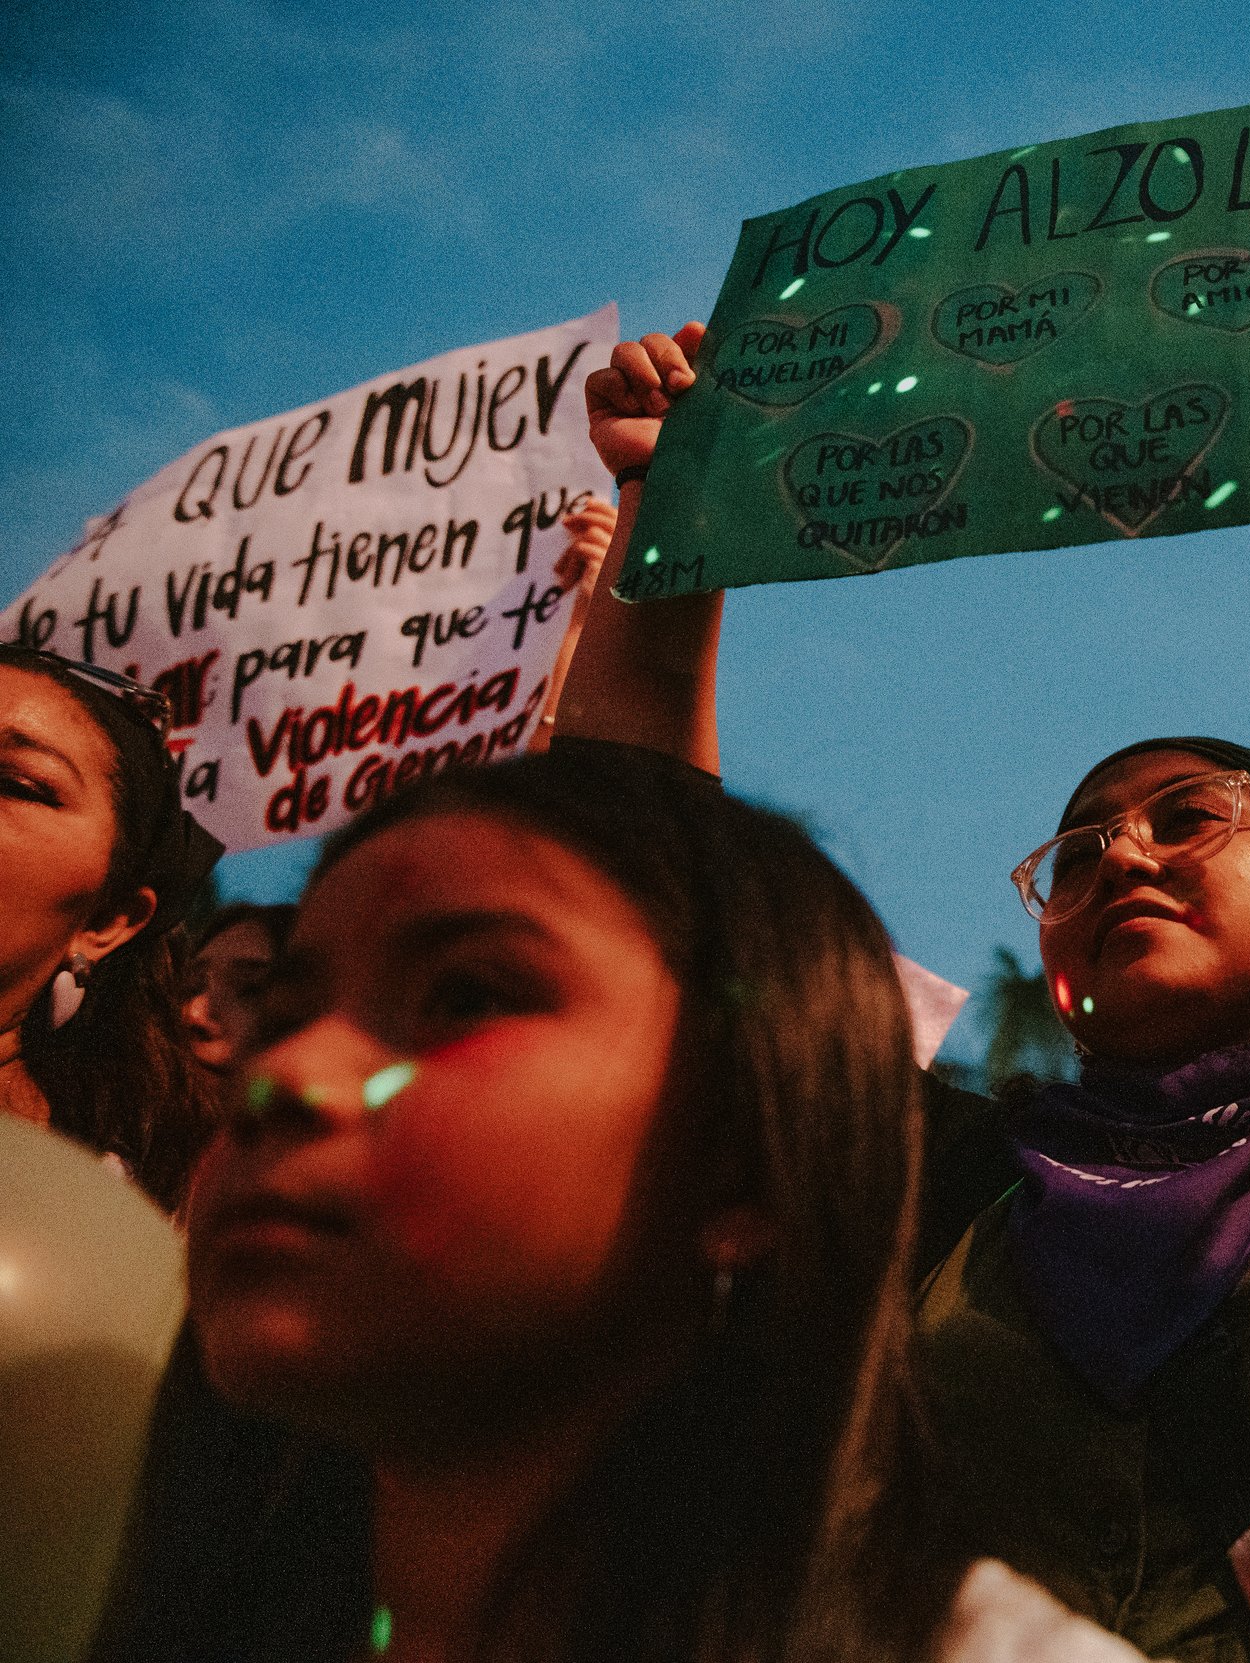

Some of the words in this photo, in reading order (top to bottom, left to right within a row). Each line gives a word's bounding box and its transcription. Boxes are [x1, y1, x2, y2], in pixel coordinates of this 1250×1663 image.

[750, 182, 937, 290] HOY
[974, 137, 1205, 252] ALZO
[1183, 261, 1245, 286] POR
[956, 293, 1018, 328] POR
[1030, 286, 1070, 309] MI
[739, 327, 798, 357] POR
[808, 322, 849, 347] MI
[957, 310, 1059, 349] MAMÁ
[714, 358, 852, 391] ABUELITA
[1060, 410, 1130, 445] POR
[1143, 397, 1211, 433] LAS
[816, 442, 876, 475] POR
[887, 431, 945, 463] LAS
[1090, 436, 1170, 472] QUE
[799, 480, 866, 510] QUE
[879, 468, 946, 501] NOS
[1056, 468, 1212, 513] VIENEN
[798, 503, 970, 550] QUITARON
[74, 575, 141, 664] tu
[290, 514, 480, 606] tienen
[501, 486, 595, 574] que
[617, 555, 704, 599] #8M
[232, 627, 368, 724] para
[400, 604, 490, 668] que
[501, 582, 561, 652] te
[264, 768, 332, 833] de
